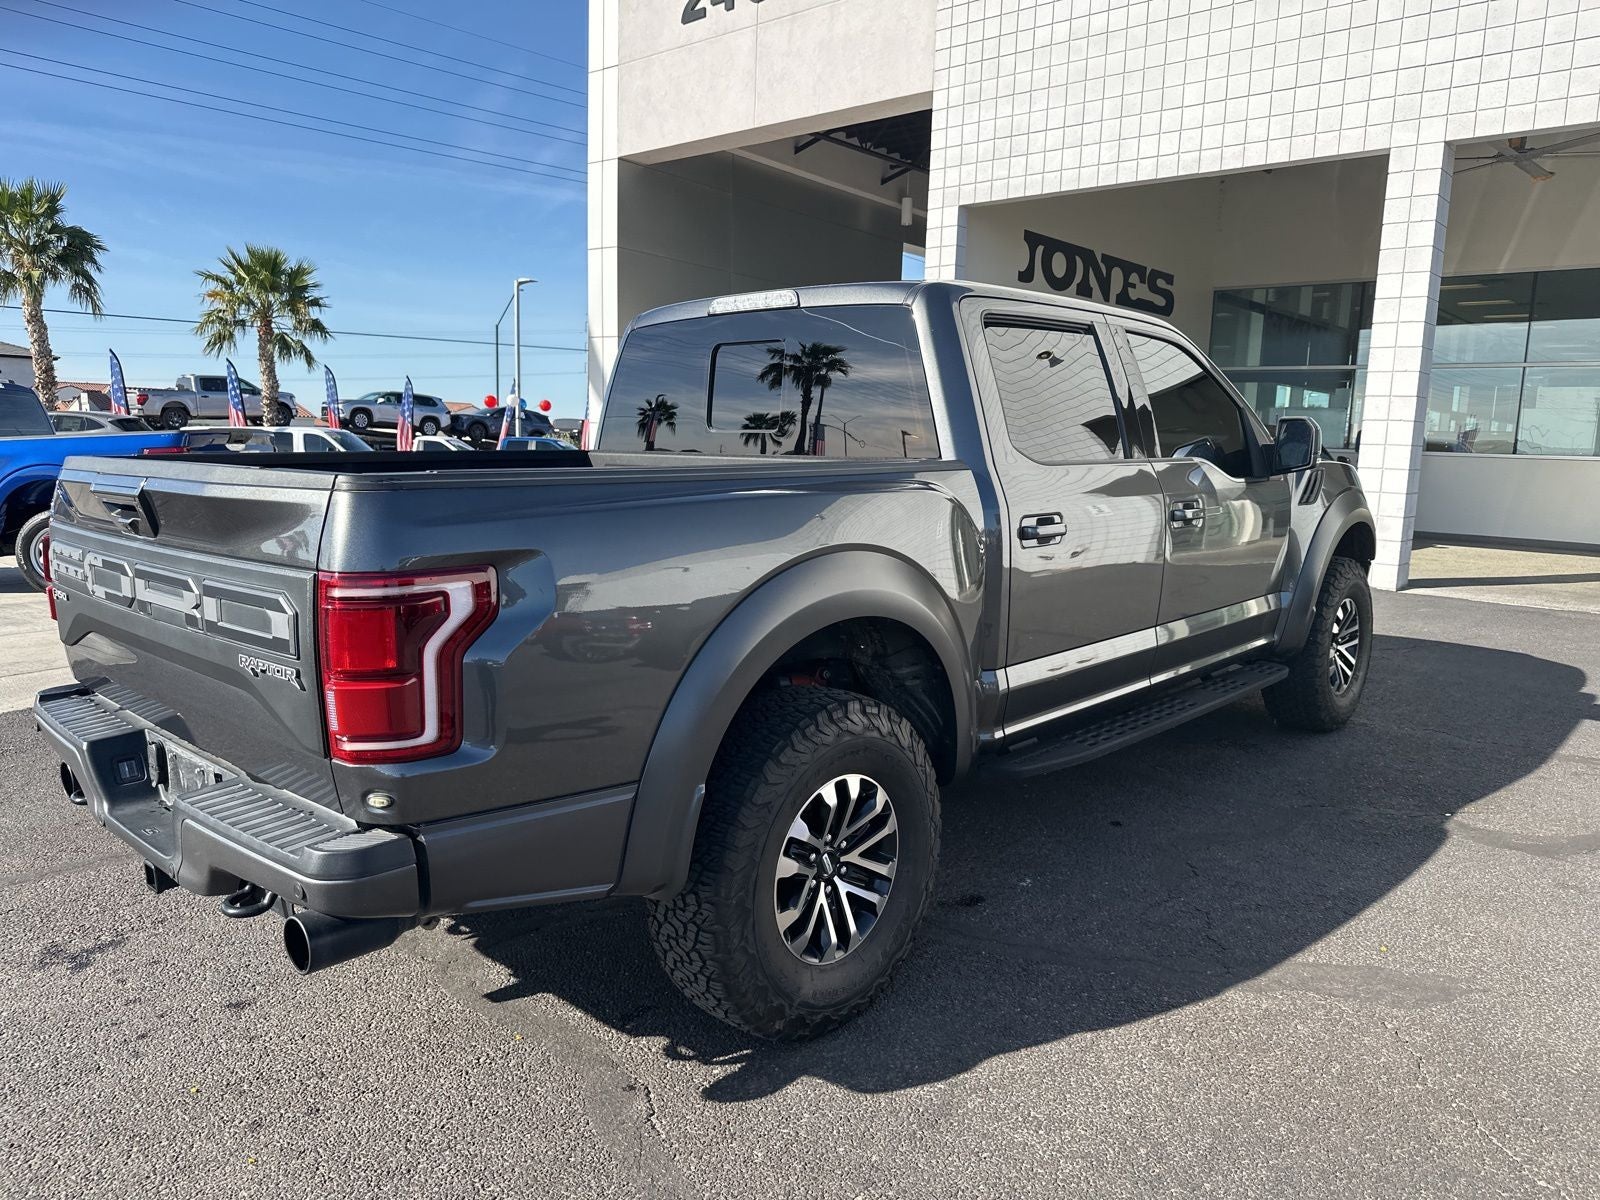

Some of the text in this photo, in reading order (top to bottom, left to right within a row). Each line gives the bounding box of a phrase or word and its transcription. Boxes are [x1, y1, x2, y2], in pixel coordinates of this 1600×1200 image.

[1018, 229, 1175, 317] JONES
[51, 540, 300, 660] FORD
[238, 653, 304, 690] RAPTOR
